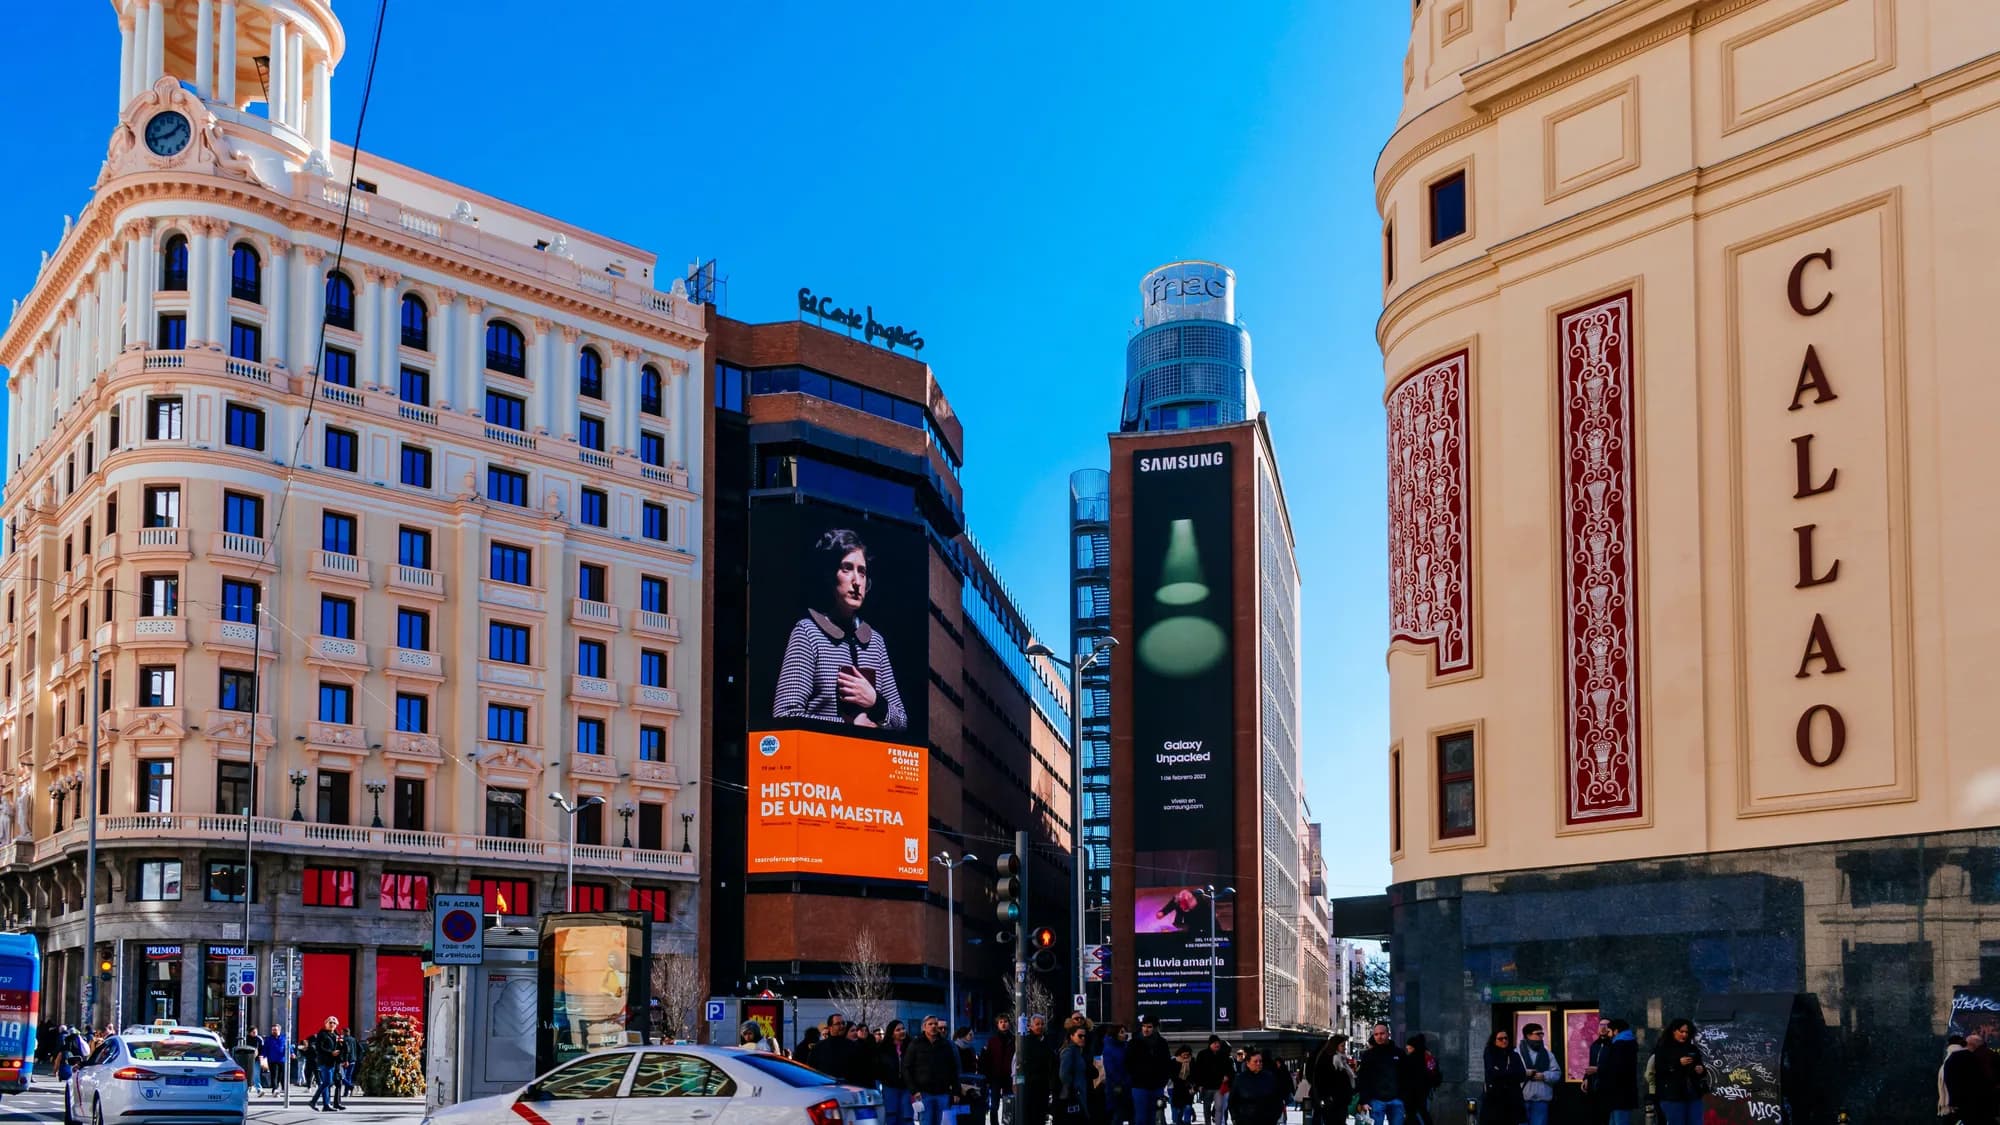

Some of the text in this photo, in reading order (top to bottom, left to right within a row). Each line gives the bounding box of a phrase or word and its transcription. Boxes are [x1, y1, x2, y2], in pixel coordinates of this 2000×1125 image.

[1150, 274, 1226, 306] fnac
[818, 296, 863, 331] Corte
[1139, 451, 1225, 473] SAMSUNG
[1786, 247, 1847, 768] CALLAO
[1163, 740, 1202, 752] Galaxy
[1156, 751, 1211, 766] Unpacked
[761, 782, 843, 801] HISTORIA
[761, 801, 785, 817] DE
[789, 801, 826, 818] UNA
[830, 804, 904, 826] MAESTRA
[1163, 803, 1204, 811] samsung.com
[898, 866, 924, 875] MADRID
[146, 946, 182, 955] PRIMOR
[1138, 956, 1225, 967] La lluvia amarila
[709, 1004, 720, 1019] P
